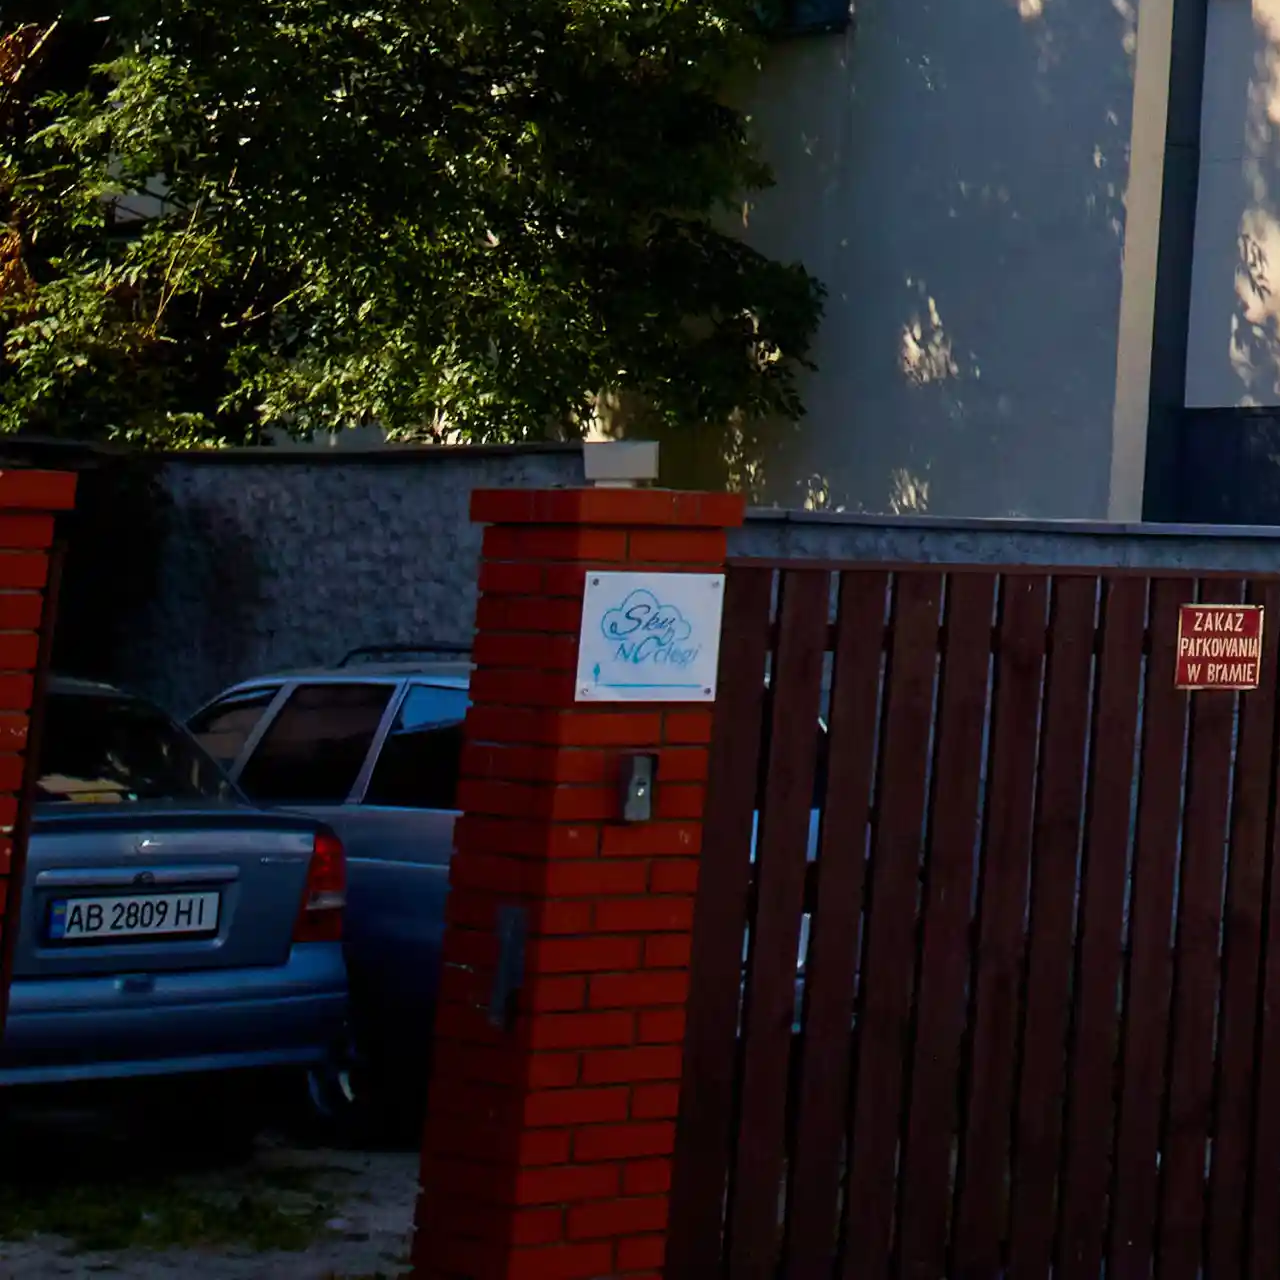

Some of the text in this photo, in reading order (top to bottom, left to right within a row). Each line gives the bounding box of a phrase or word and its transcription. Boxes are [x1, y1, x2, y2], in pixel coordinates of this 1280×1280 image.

[609, 604, 676, 645] Sky
[1193, 612, 1244, 632] ZAKAZ
[1187, 663, 1202, 683] W
[66, 898, 205, 933] AB 2809 HI
